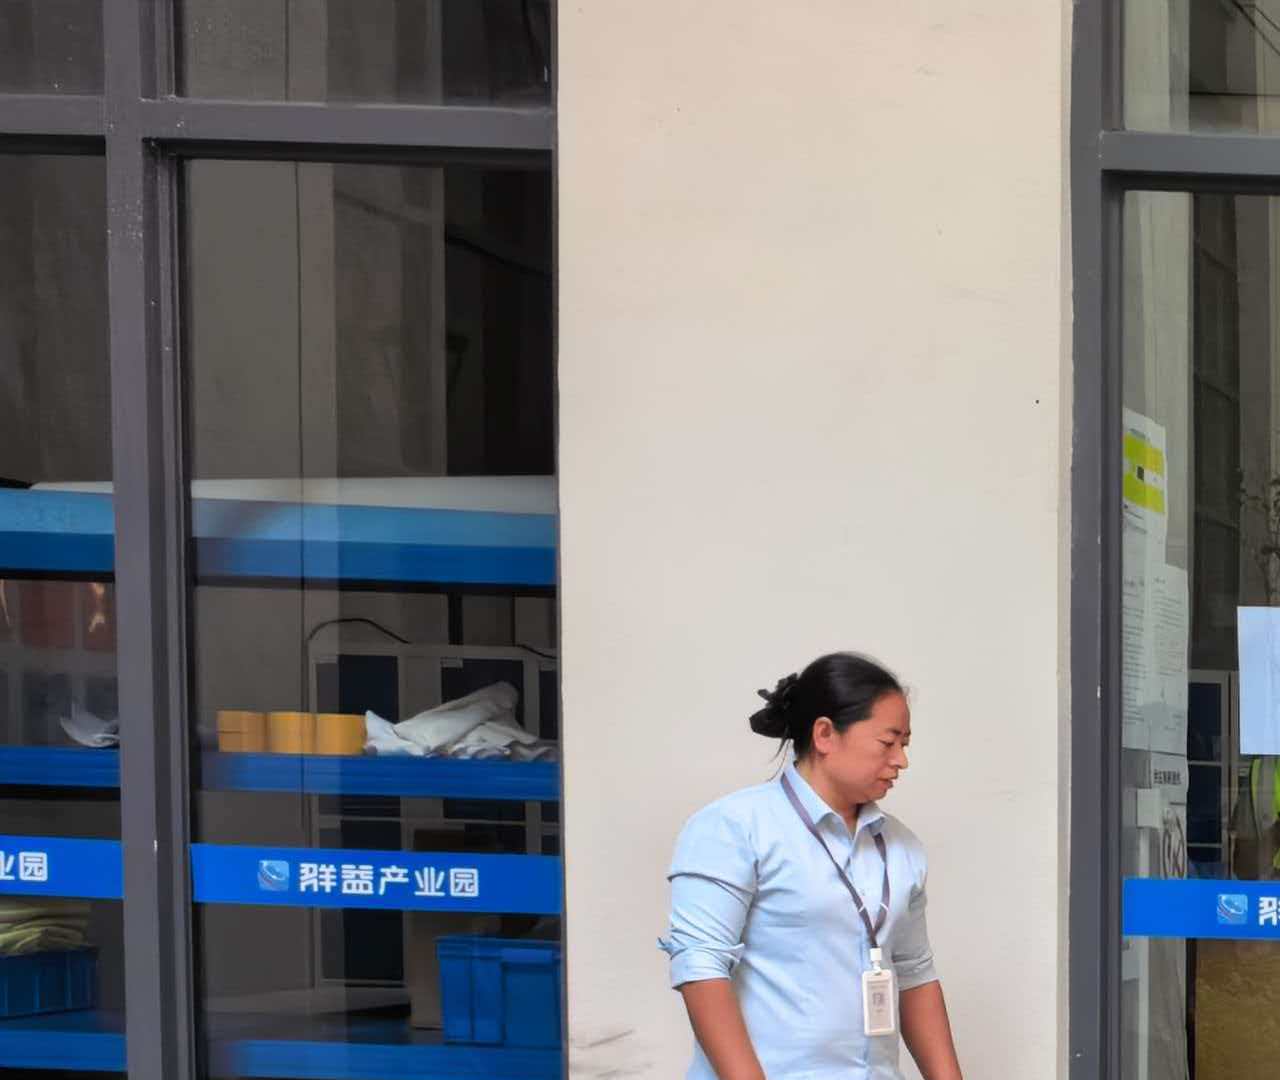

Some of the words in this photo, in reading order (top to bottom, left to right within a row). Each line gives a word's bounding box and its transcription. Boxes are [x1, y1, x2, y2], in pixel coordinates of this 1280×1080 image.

[299, 862, 478, 898] 群益产业园
